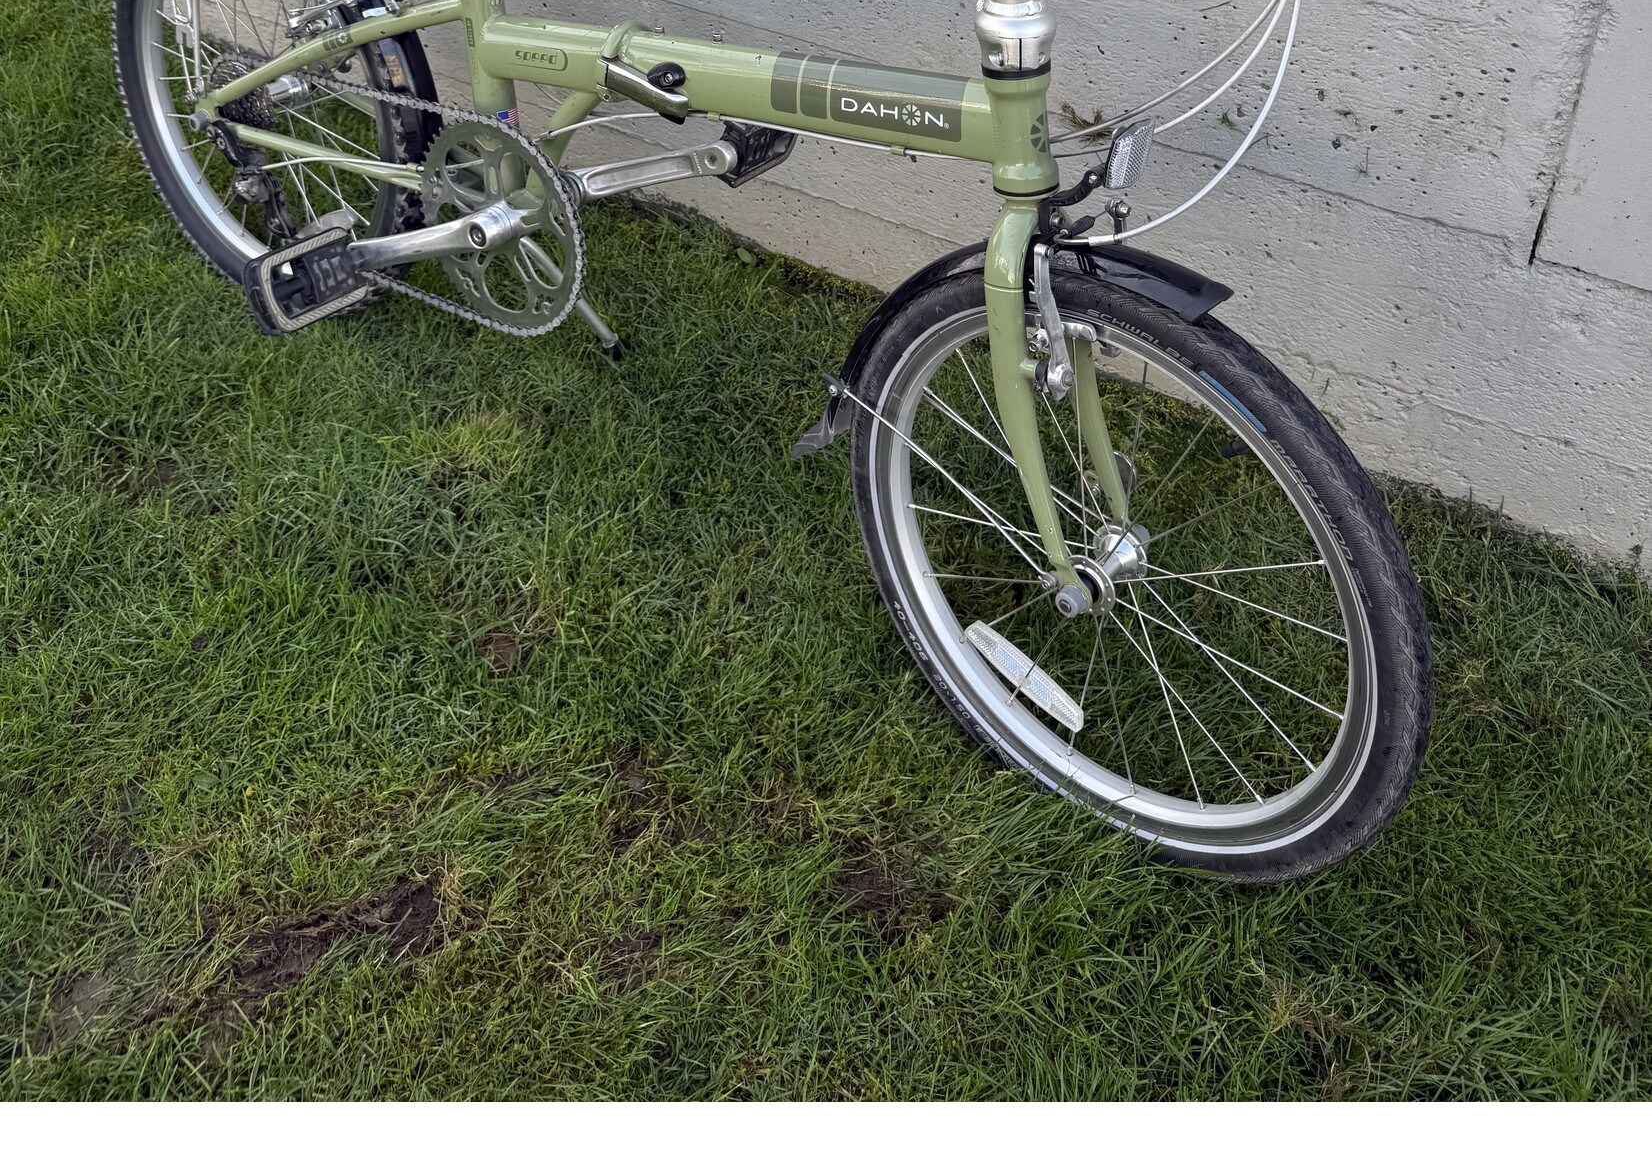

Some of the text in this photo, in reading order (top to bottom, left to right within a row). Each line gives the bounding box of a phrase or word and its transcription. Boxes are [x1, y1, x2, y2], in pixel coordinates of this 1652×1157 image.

[841, 97, 944, 129] DAHON
[1086, 308, 1195, 368] SCHWALBE
[1270, 439, 1354, 562] MARATHON
[893, 600, 929, 661] 40-406
